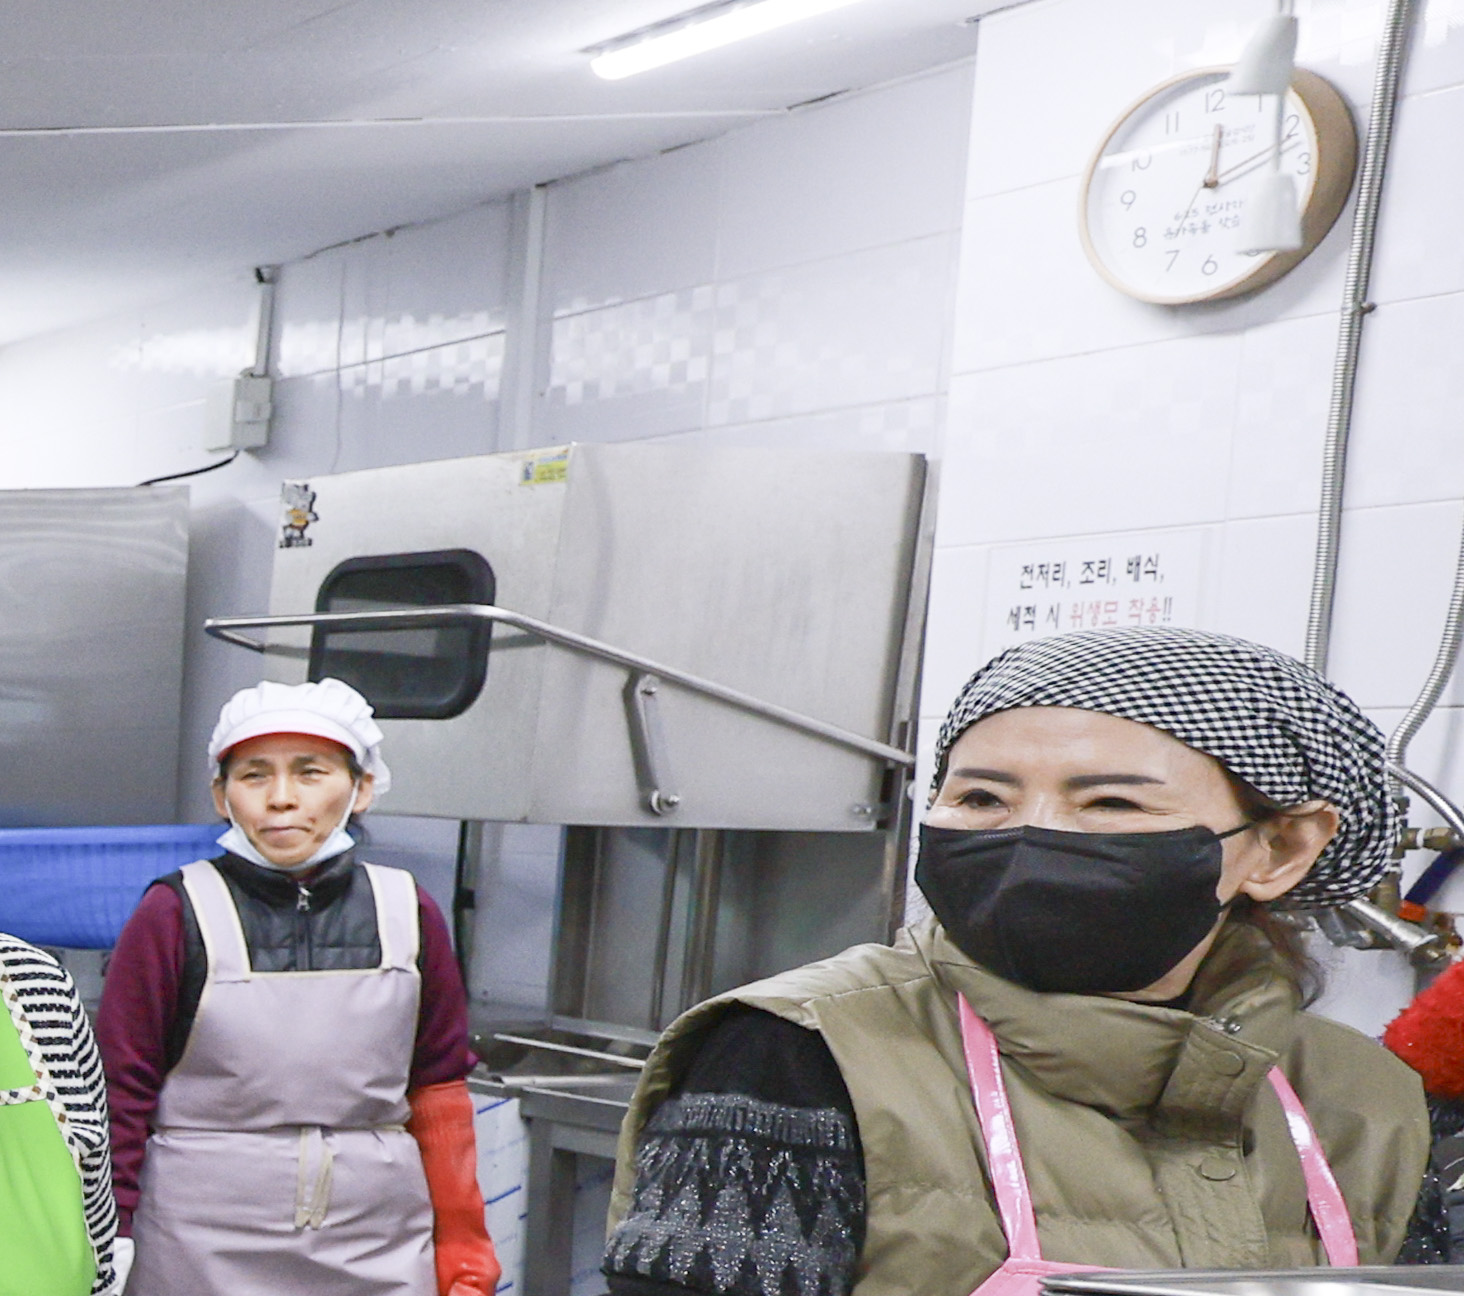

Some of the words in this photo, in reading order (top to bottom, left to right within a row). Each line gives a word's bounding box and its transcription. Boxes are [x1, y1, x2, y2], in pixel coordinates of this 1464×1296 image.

[1204, 88, 1226, 114] 12
[1165, 111, 1180, 136] 11
[1284, 114, 1301, 140] 2
[1296, 153, 1312, 175] 3
[1120, 189, 1137, 211] 9
[1132, 226, 1148, 249] 8
[1164, 249, 1181, 273] 7
[1201, 253, 1219, 276] 6
[1126, 553, 1164, 583] 배식,
[1046, 601, 1061, 630] 시
[1069, 599, 1119, 628] 위생모
[1128, 595, 1173, 625] 착용!!
